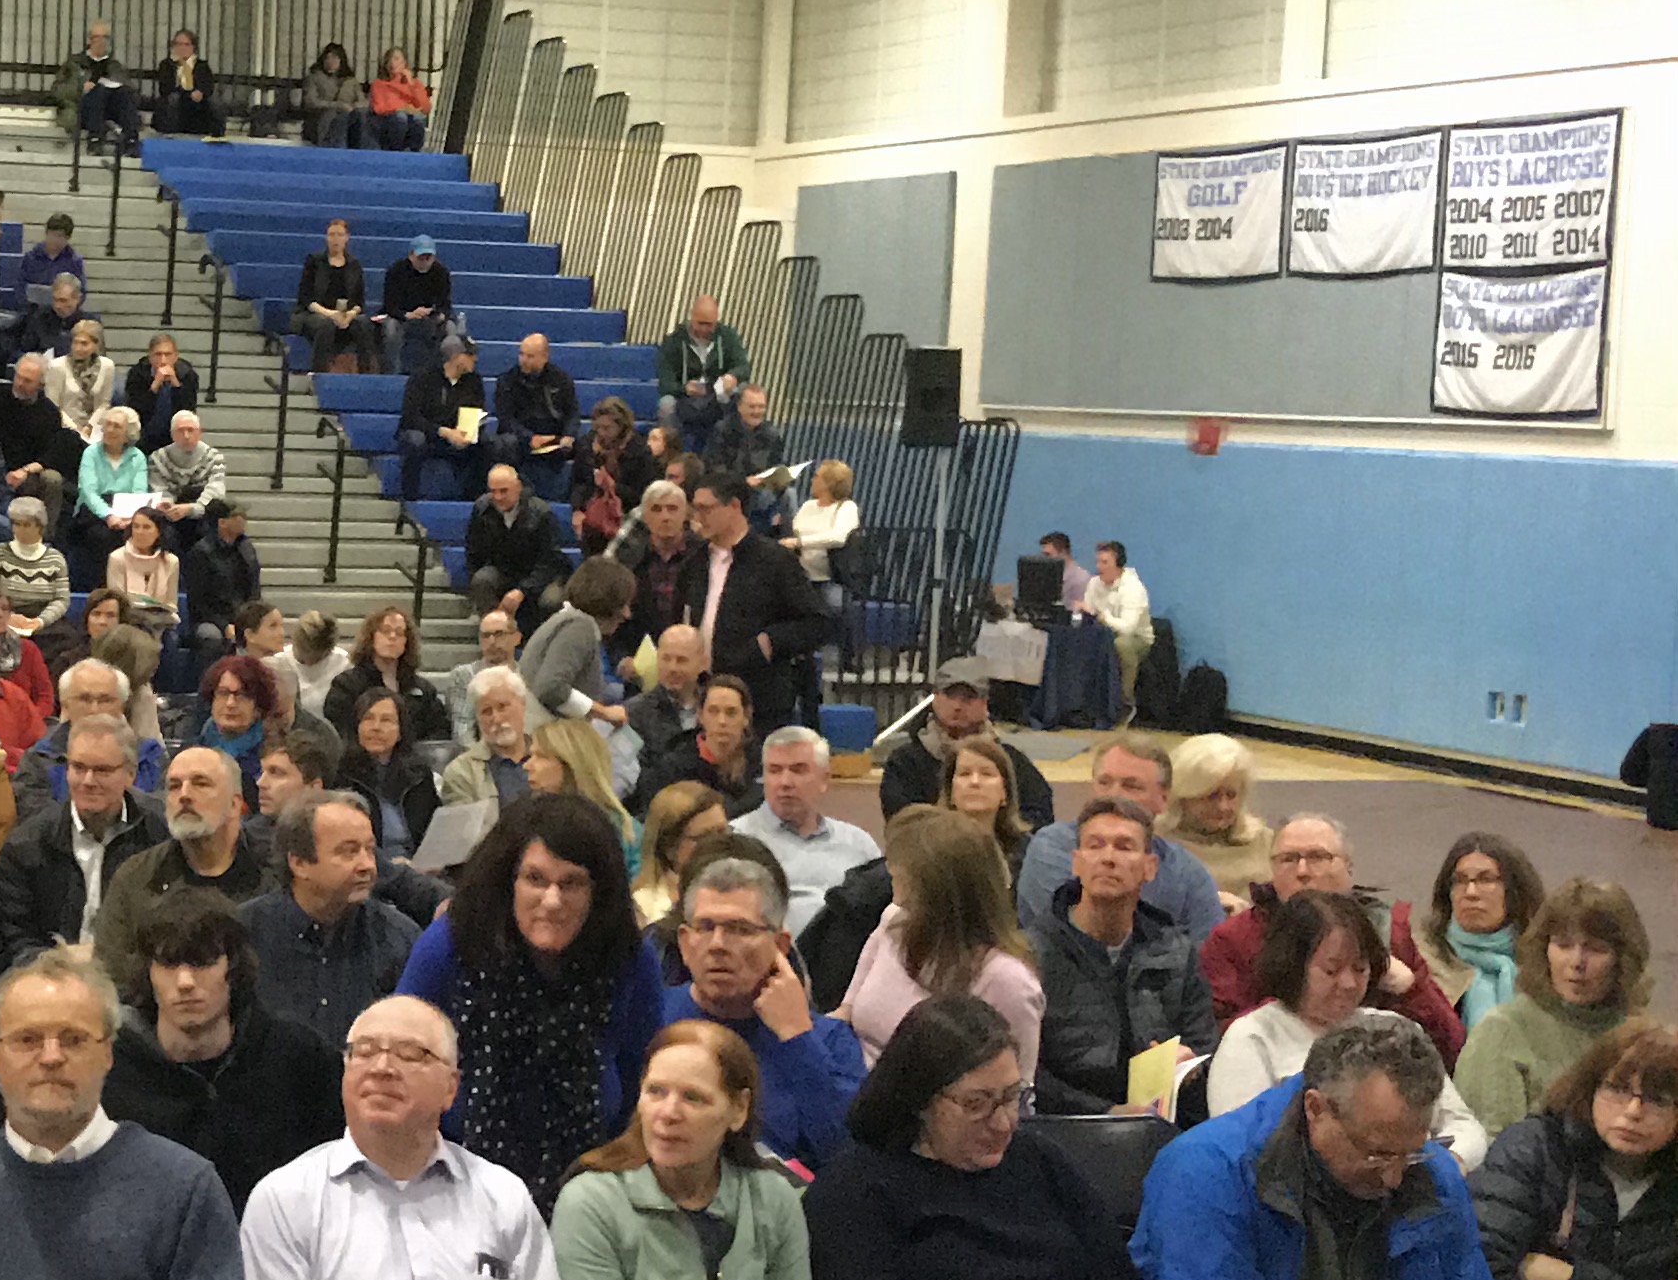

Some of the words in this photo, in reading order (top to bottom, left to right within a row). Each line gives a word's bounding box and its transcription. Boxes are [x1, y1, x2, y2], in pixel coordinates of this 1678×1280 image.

[1298, 150, 1344, 169] STATE
[1346, 139, 1436, 168] CHAMPIONS
[1453, 134, 1504, 157] STATE
[1508, 123, 1611, 154] CHAMPIONS
[1160, 161, 1201, 180] STATE
[1204, 152, 1282, 179] CHAMPIONS
[1339, 173, 1362, 198] ICE
[1366, 165, 1433, 196] HOCKEY
[1450, 159, 1500, 187] BOYS
[1506, 149, 1608, 186] LACROSSE
[1187, 181, 1248, 208] GOLF
[1449, 197, 1493, 223] 2004
[1501, 195, 1547, 223] 2005
[1554, 188, 1605, 219] 2007
[1156, 217, 1190, 241] 2003
[1195, 216, 1233, 241] 2004
[1293, 208, 1330, 233] 2016
[1450, 233, 1487, 259] 2010
[1502, 231, 1538, 259] 2011
[1553, 225, 1600, 256] 2014
[1493, 300, 1598, 334] LACROSSE
[1440, 340, 1481, 368] 2015
[1493, 344, 1536, 370] 2016
